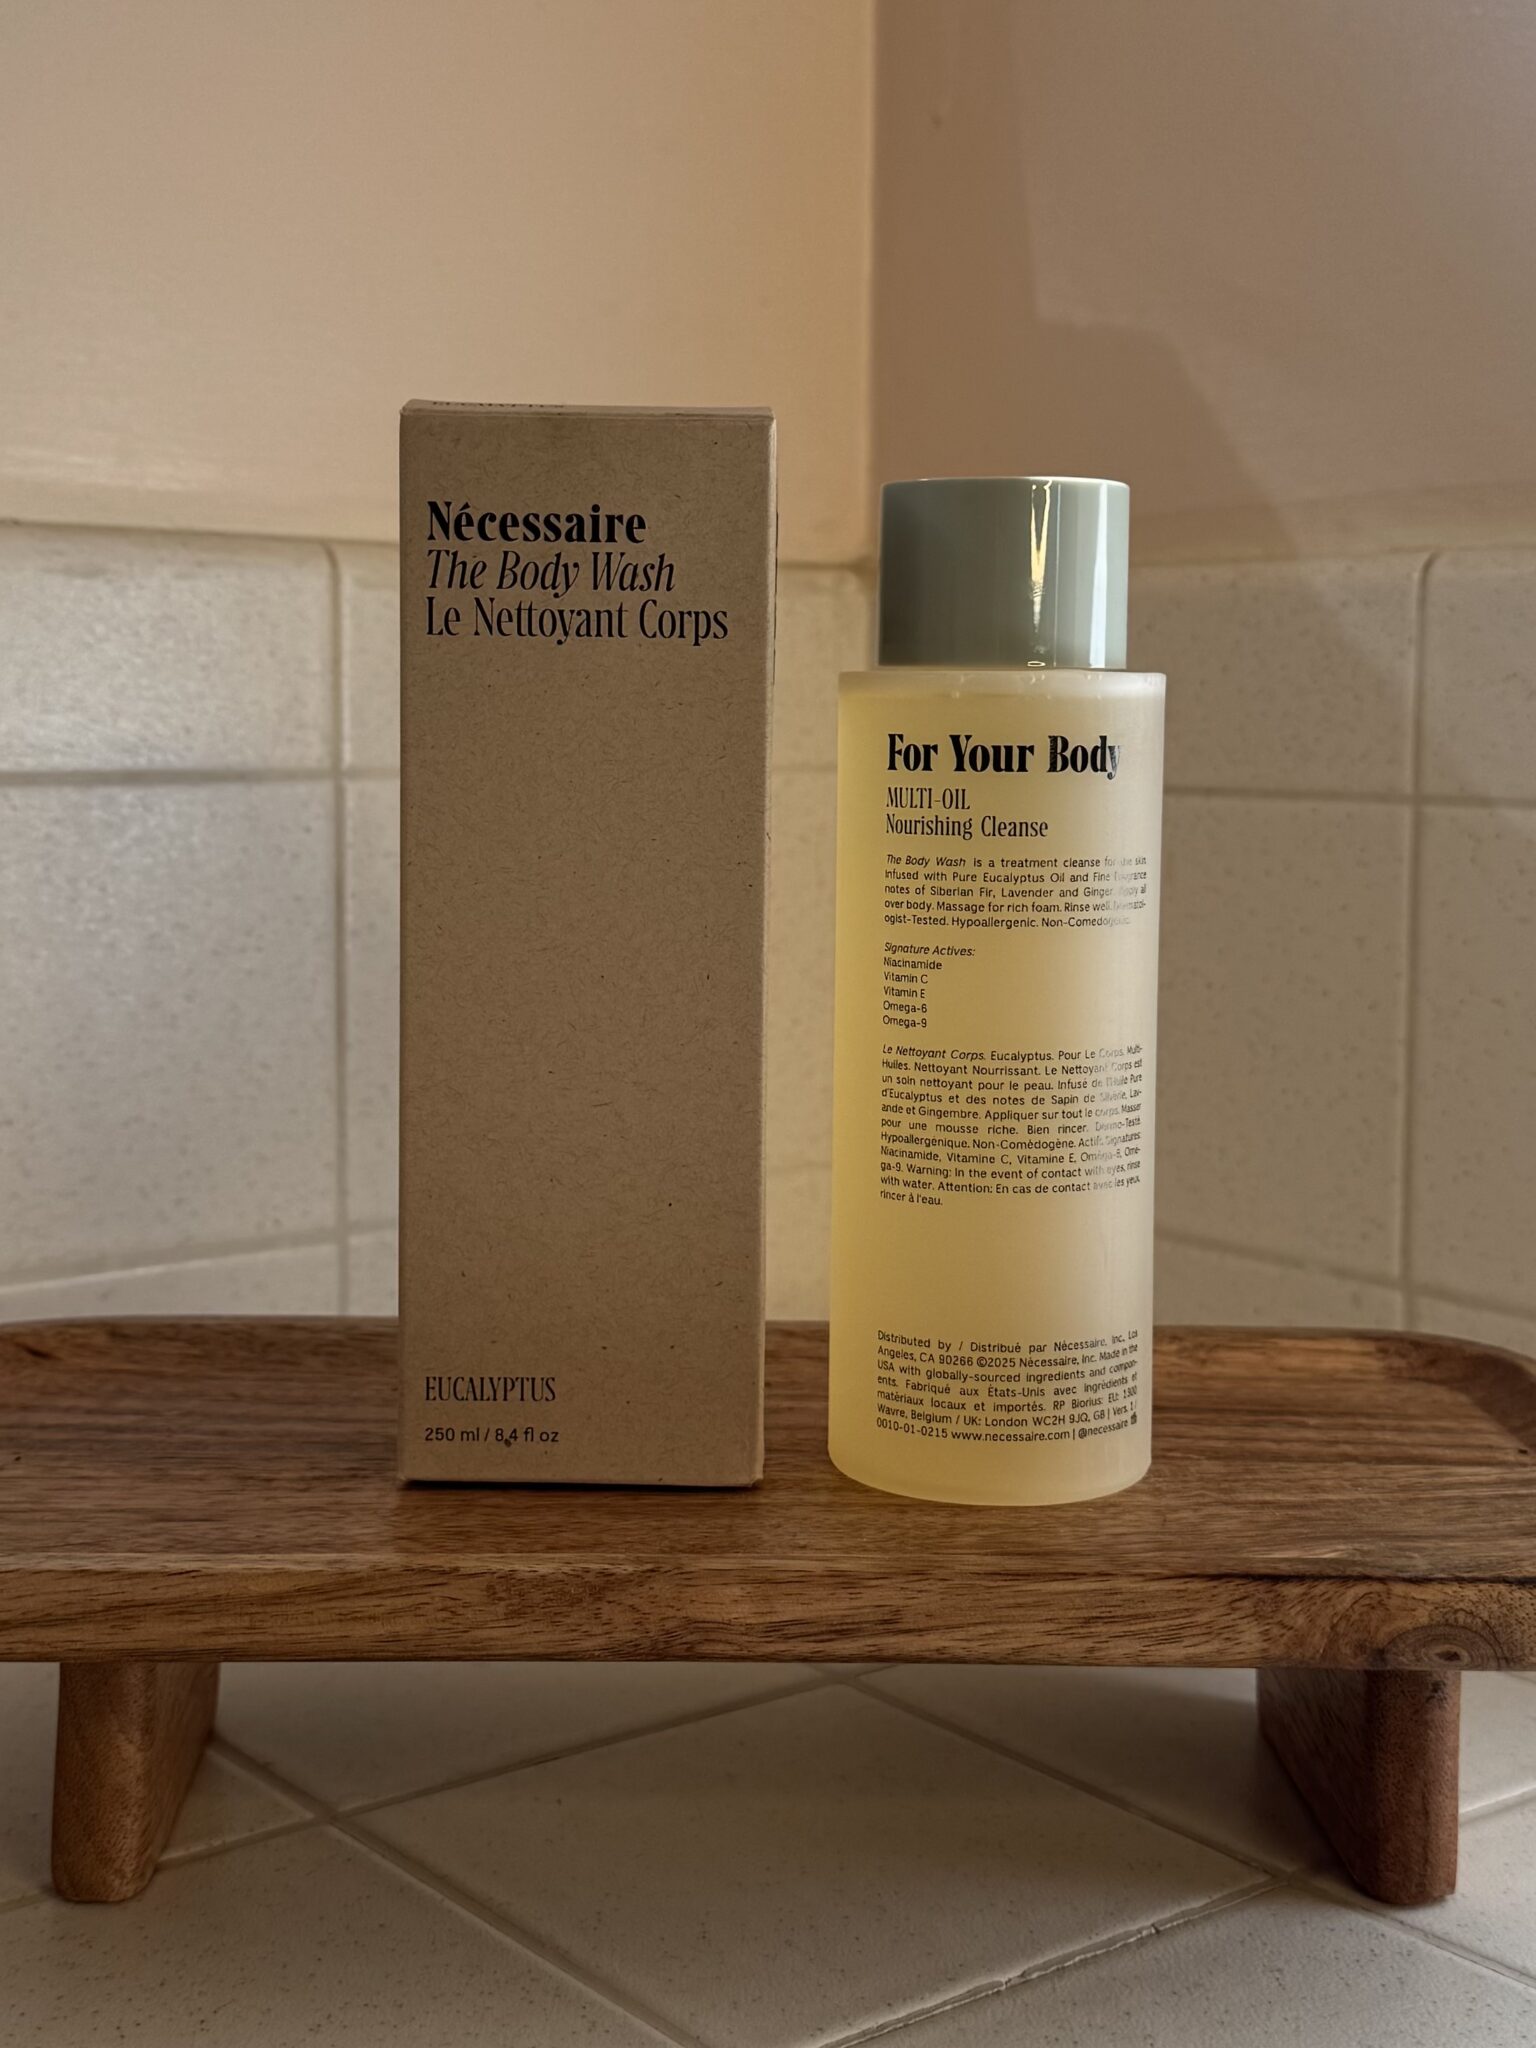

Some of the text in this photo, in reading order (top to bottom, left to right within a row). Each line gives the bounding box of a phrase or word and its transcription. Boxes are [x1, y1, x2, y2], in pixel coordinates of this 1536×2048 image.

[426, 500, 647, 544] Nécessaire
[428, 548, 675, 598] The Body Wash
[425, 596, 728, 646] Le Nettoyant Corps
[886, 733, 1121, 780] For Your Body
[885, 786, 971, 810] MULTI-OIL
[885, 813, 1049, 841] Nourishing Cleanse
[886, 855, 1101, 868] The Body Wash is a treatment cleanse
[923, 871, 947, 882] with
[952, 871, 977, 883] Pure
[983, 872, 1045, 885] Eucalyptus
[1050, 872, 1065, 883] Oil
[1070, 872, 1089, 882] and
[885, 885, 910, 895] notes
[915, 885, 925, 896] of
[930, 886, 974, 897] Siberian
[1001, 887, 1054, 898] Lavender
[1059, 887, 1079, 897] and
[885, 899, 905, 909] over
[936, 901, 985, 913] Massage
[988, 902, 1005, 913] for
[1007, 902, 1029, 913] rich
[1064, 902, 1090, 913] Rinse
[884, 942, 930, 955] Signature
[883, 957, 943, 970] Niacinamide
[884, 972, 928, 984] Vitamin C
[883, 986, 926, 999] Vitamin E
[883, 1000, 928, 1014] Omega-6
[882, 1014, 927, 1029] Omega-9
[882, 1044, 893, 1054] Le
[895, 1045, 947, 1060] Nettoyant
[1058, 1050, 1081, 1061] Pour
[1085, 1049, 1096, 1059] Le
[914, 1061, 968, 1075] Nettoyant
[1045, 1065, 1057, 1076] Le
[882, 1075, 893, 1084] un
[896, 1074, 916, 1085] soin
[920, 1077, 973, 1090] nettoyant
[978, 1081, 1005, 1092] pour
[1009, 1080, 1019, 1091] le
[882, 1088, 942, 1103] d'Eucalyptus
[948, 1094, 960, 1104] et
[966, 1094, 986, 1105] des
[992, 1095, 1025, 1106] notes
[1031, 1095, 1045, 1106] de
[1051, 1094, 1079, 1106] Sapin
[1083, 1092, 1096, 1103] de
[881, 1103, 904, 1114] ande
[906, 1105, 916, 1115] et
[985, 1110, 1039, 1121] Appliquer
[1042, 1110, 1059, 1120] sur
[1061, 1108, 1083, 1119] tout
[1085, 1107, 1093, 1118] le
[881, 1118, 901, 1130] pour
[908, 1122, 927, 1131] une
[935, 1124, 979, 1134] mousse
[1027, 1124, 1050, 1135] Bien
[946, 1152, 995, 1164] Vitamine
[1017, 1153, 1065, 1165] Vitamine
[954, 1167, 965, 1178] In
[968, 1168, 987, 1179] the
[991, 1169, 1023, 1179] event
[1026, 1168, 1038, 1179] of
[1041, 1167, 1082, 1179] contact
[880, 1176, 900, 1186] with
[995, 1183, 1009, 1194] En
[1012, 1184, 1031, 1194] cas
[1034, 1182, 1049, 1194] de
[1052, 1181, 1091, 1193] contact
[880, 1189, 906, 1201] rincer
[908, 1192, 915, 1203] à
[878, 1330, 931, 1348] Distributed
[938, 1339, 951, 1352] by
[1029, 1343, 1047, 1355] par
[919, 1352, 935, 1363] CA
[938, 1354, 974, 1366] 90266
[976, 1356, 1016, 1368] ©2025
[878, 1360, 1107, 1383] USA with globally-sourced ingredients and
[424, 1376, 556, 1401] EUCALYPTUS
[959, 1387, 979, 1397] aux
[988, 1384, 1045, 1397] États-Unis
[1053, 1386, 1077, 1396] avec
[931, 1397, 967, 1410] locaux
[974, 1401, 985, 1412] et
[1053, 1399, 1066, 1410] RP
[911, 1409, 952, 1425] Belgium
[985, 1416, 1028, 1428] London
[1033, 1416, 1066, 1426] WC2H
[1093, 1409, 1105, 1420] GB
[424, 1427, 455, 1442] 250
[460, 1427, 480, 1442] ml
[524, 1427, 535, 1442] fl
[539, 1430, 560, 1443] oz
[876, 1417, 1128, 1443] 0010-01-0215 www.necessaire.com @necessaire
